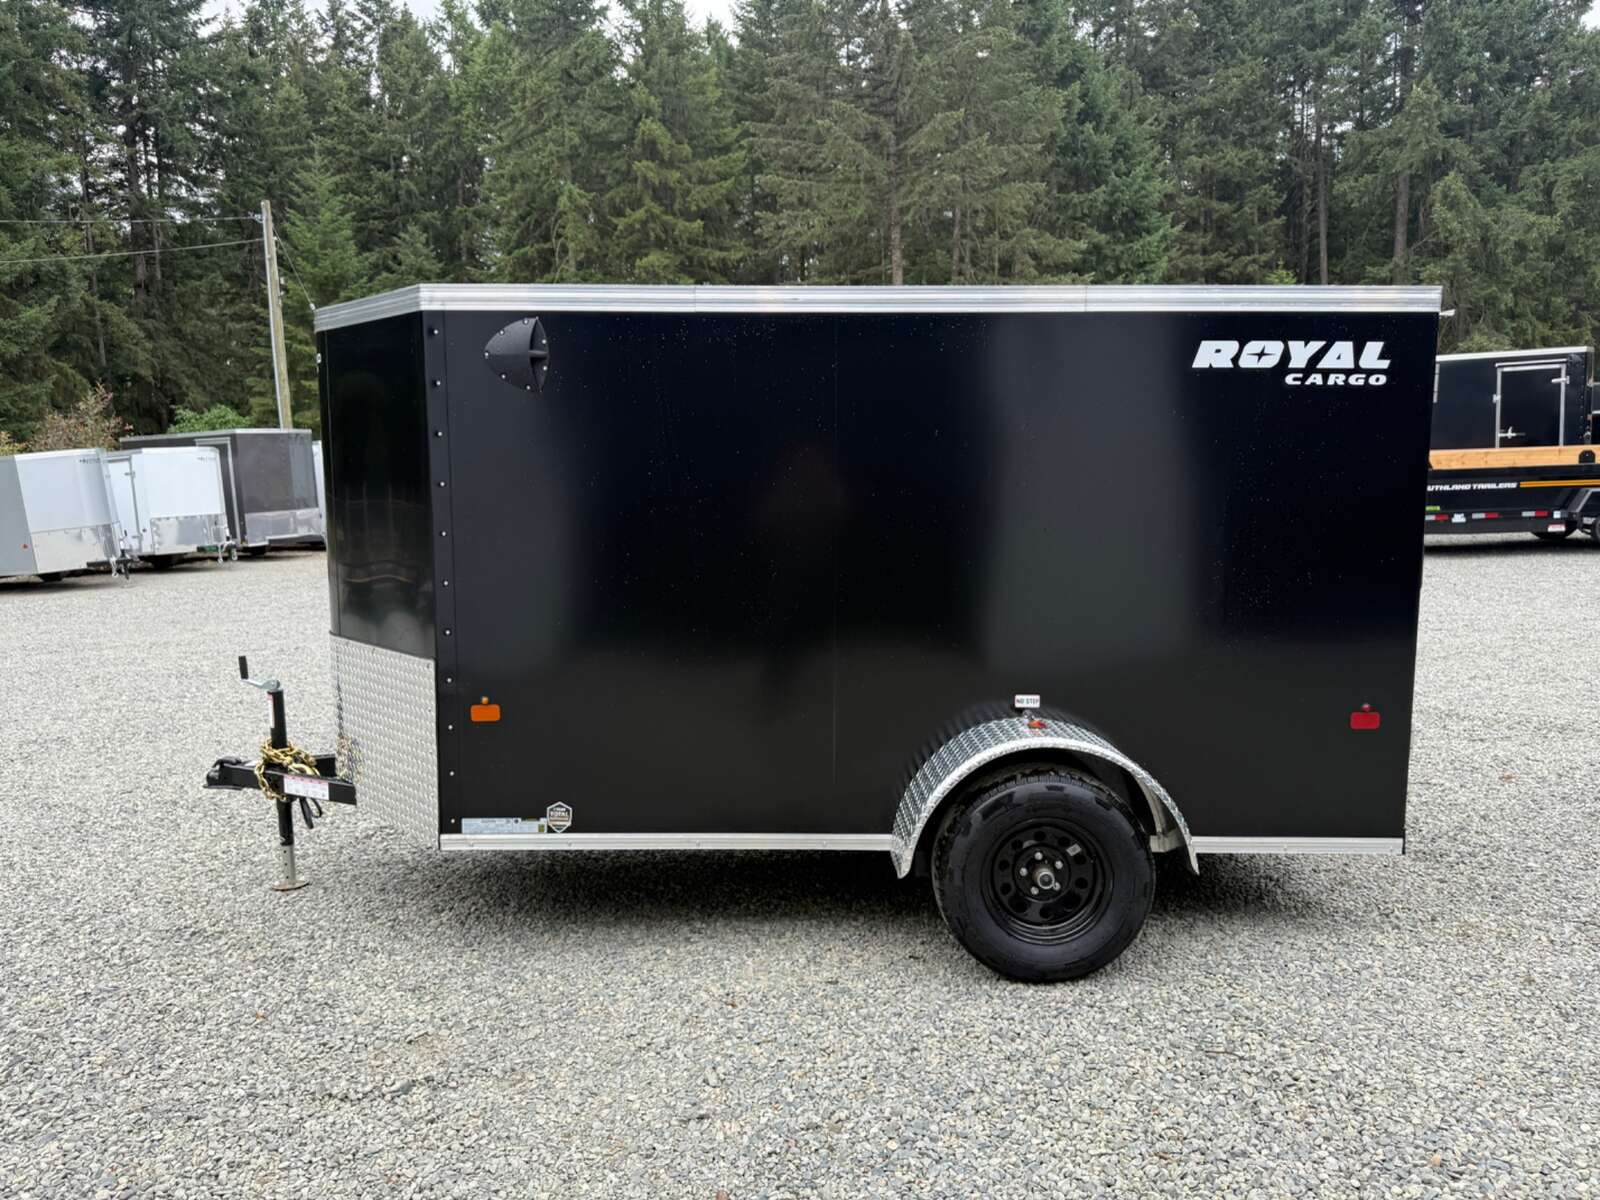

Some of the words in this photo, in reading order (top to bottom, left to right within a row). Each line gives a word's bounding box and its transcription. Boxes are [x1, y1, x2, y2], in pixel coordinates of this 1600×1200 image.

[1191, 340, 1391, 369] ROYAL
[1284, 373, 1387, 386] CARGO
[1426, 484, 1472, 492] UTHLAND
[1472, 482, 1518, 490] TRAILERS
